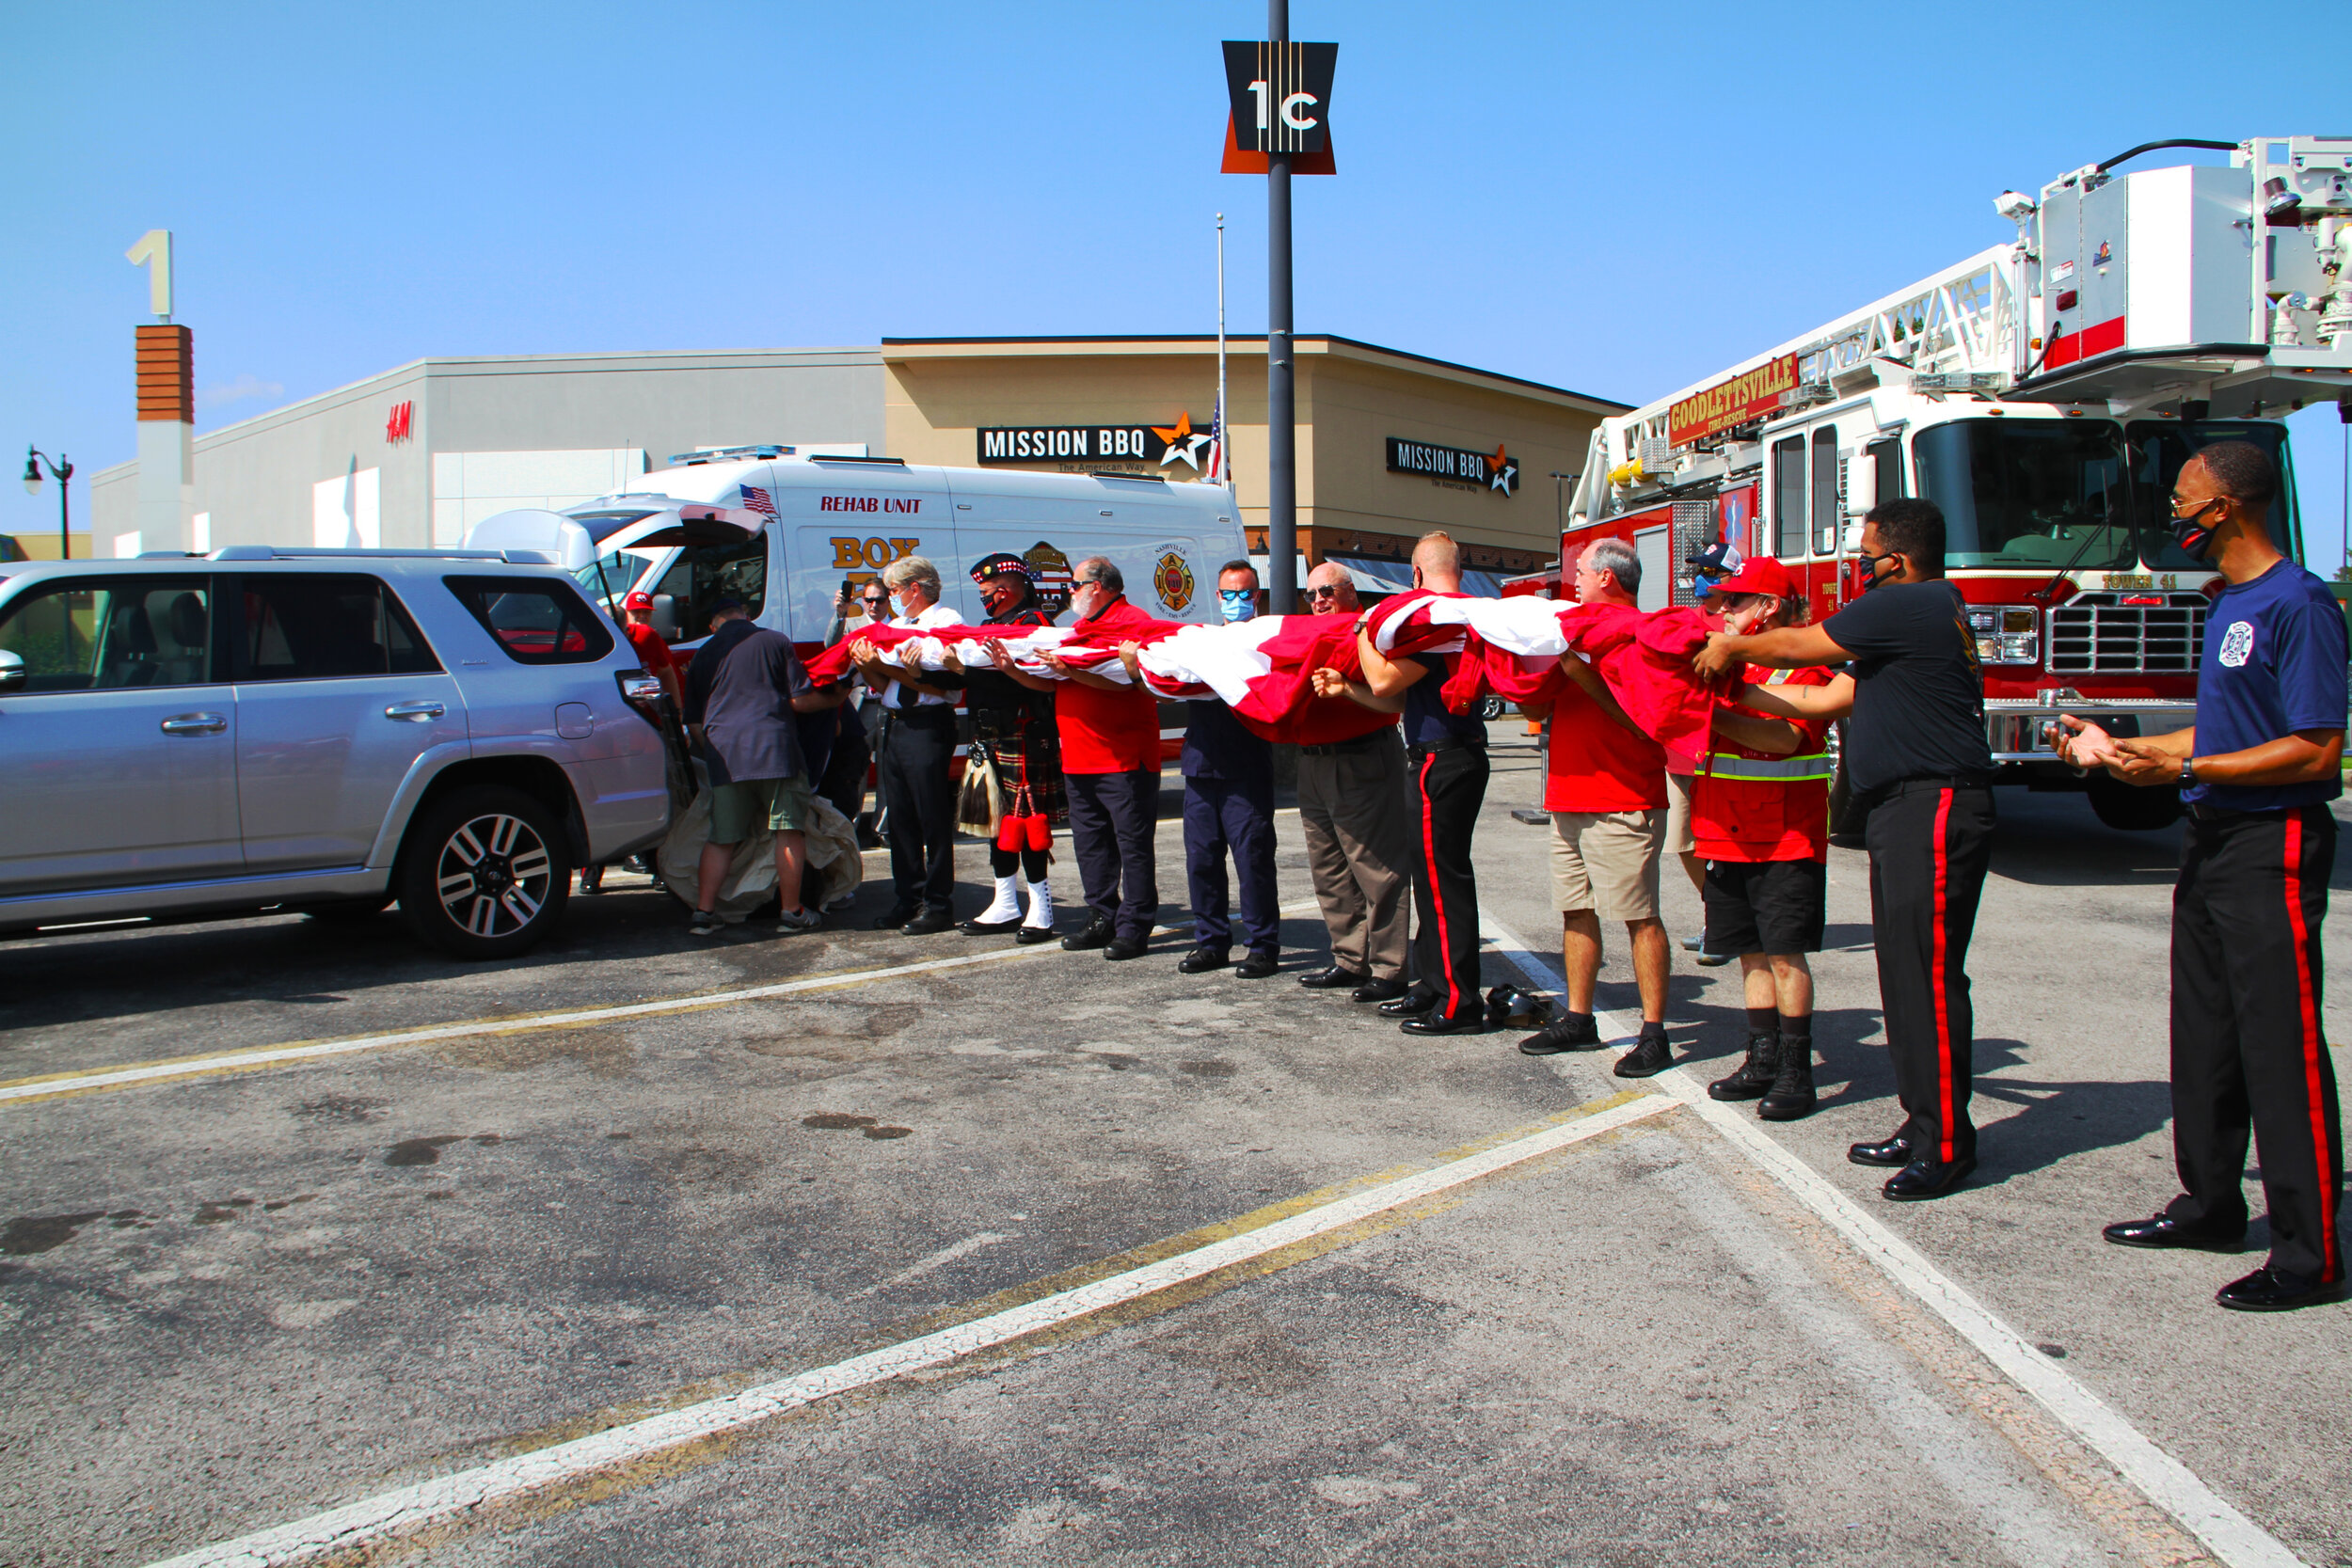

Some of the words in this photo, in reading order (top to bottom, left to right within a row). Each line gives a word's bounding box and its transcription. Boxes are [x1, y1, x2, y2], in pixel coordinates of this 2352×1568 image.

[125, 230, 173, 315] 1
[1671, 356, 1793, 432] GOODLETTSVILLE
[387, 400, 411, 443] H&M
[1708, 408, 1747, 433] FIRE-RESCUE
[985, 430, 1088, 457] MISSION
[1099, 429, 1145, 458] BBQ
[1058, 463, 1074, 472] The
[1078, 463, 1122, 472] American
[1398, 442, 1454, 475] MISSION
[1459, 452, 1484, 483] BBQ
[1431, 479, 1441, 487] The
[1441, 481, 1466, 491] American
[820, 496, 879, 513] REHAB
[884, 498, 922, 514] UNIT
[829, 536, 920, 570] BOX
[1154, 544, 1188, 556] NASHVILLE
[2102, 575, 2153, 589] TOWER
[2160, 574, 2177, 589] 41
